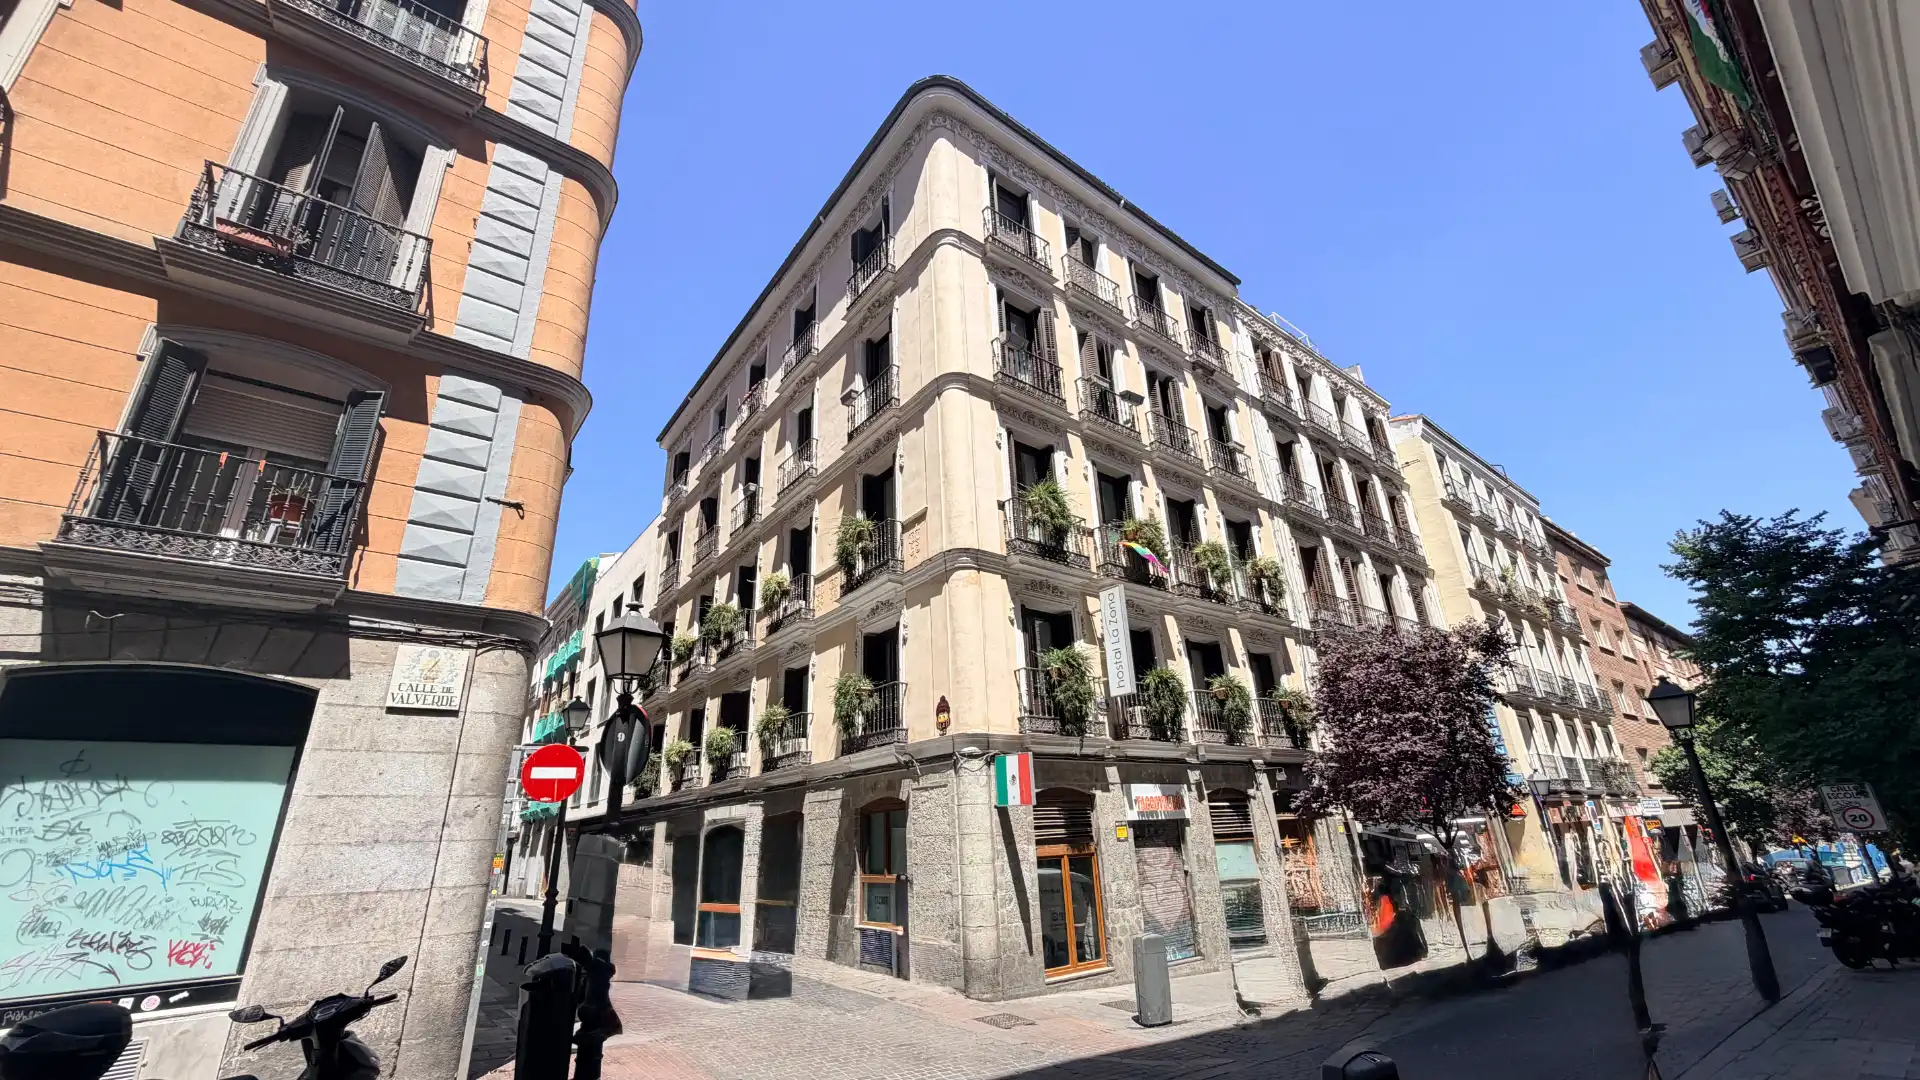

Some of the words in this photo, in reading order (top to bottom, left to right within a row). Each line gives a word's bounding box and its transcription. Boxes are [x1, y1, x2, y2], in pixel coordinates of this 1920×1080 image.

[398, 682, 438, 694] CALLE
[441, 686, 455, 694] DE
[390, 692, 459, 708] VALVERDE
[1848, 813, 1868, 822] 20
